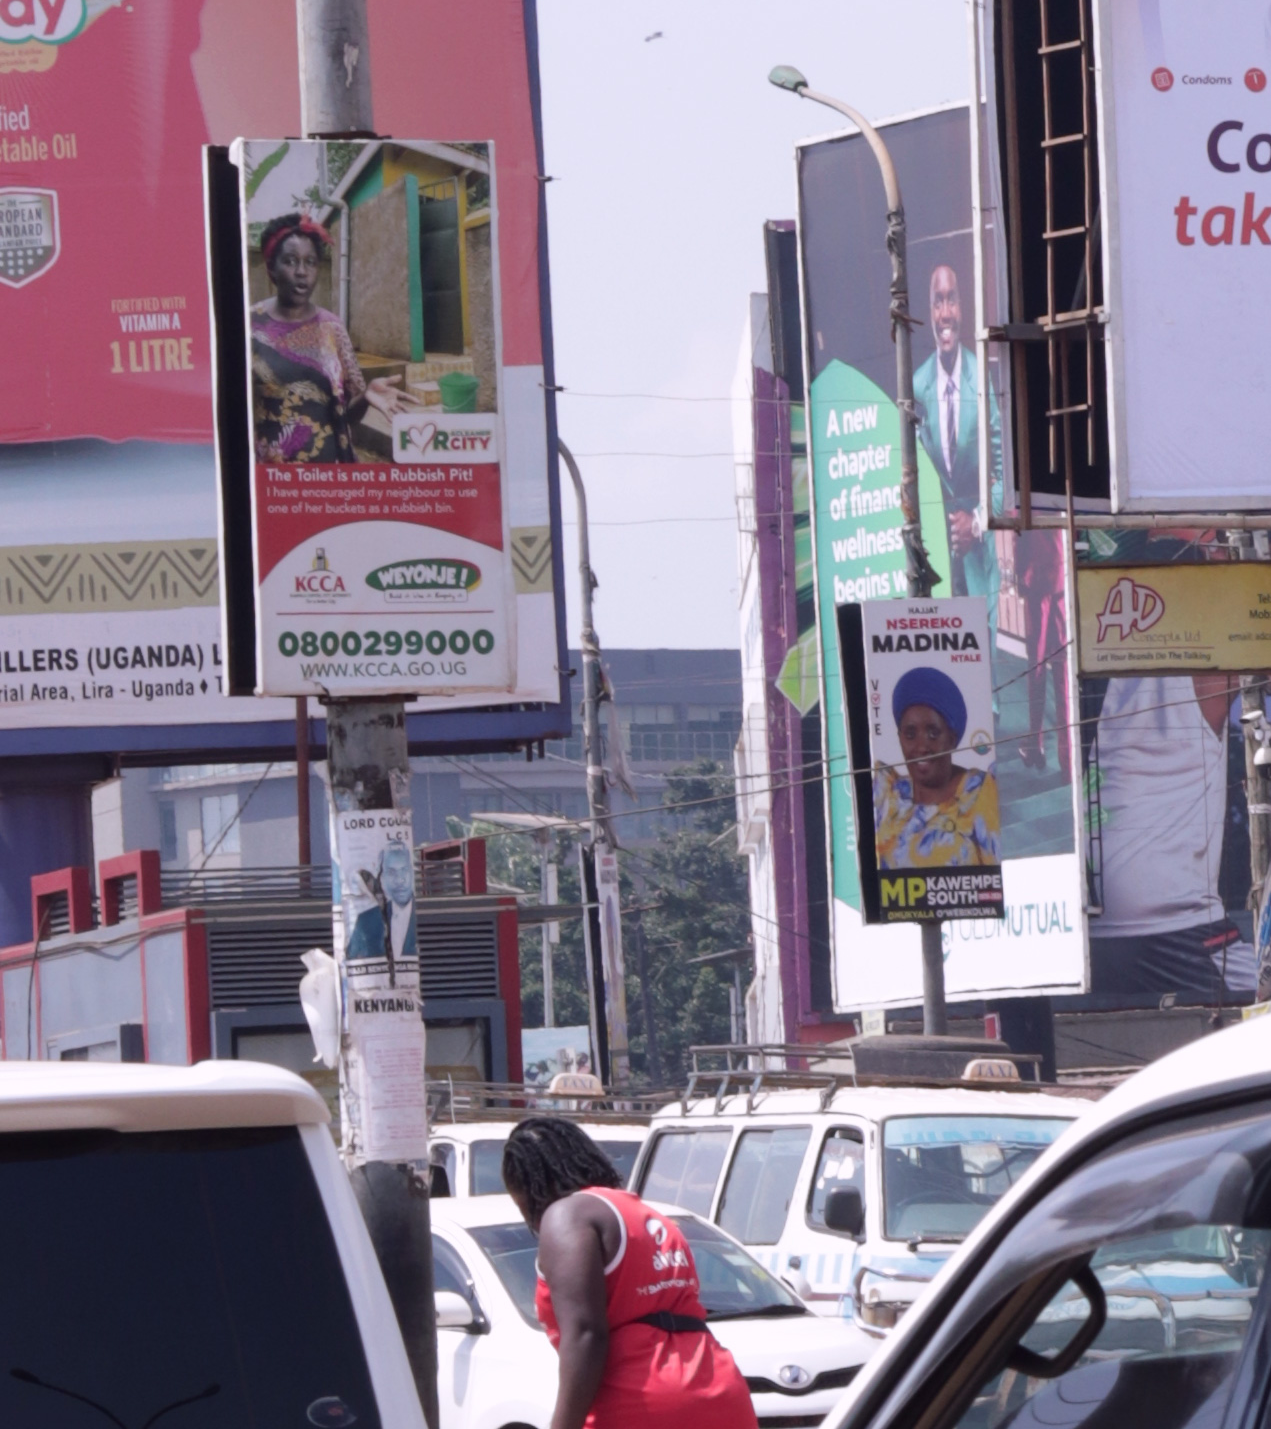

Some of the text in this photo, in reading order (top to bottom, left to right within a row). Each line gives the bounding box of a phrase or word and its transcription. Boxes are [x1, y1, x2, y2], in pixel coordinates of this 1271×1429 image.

[1181, 74, 1233, 86] Condoms
[52, 132, 77, 159] Oil
[119, 312, 181, 332] VITAMIN A
[110, 337, 194, 374] 1 LITRE
[826, 405, 879, 438] A new
[450, 437, 490, 450] CITY
[828, 444, 891, 481] chapter
[266, 467, 474, 482] The Toilet is not a Rubbish Pit!
[272, 486, 478, 500] have encouraged my neighbour to use
[267, 504, 288, 514] one
[291, 502, 304, 514] of
[305, 503, 322, 514] her
[325, 502, 367, 514] buckets
[368, 504, 380, 514] as
[392, 502, 433, 514] rubbish
[830, 488, 847, 521] of
[832, 526, 904, 563] wellness
[295, 575, 345, 592] KCCA
[1257, 593, 1271, 604] Tel:
[1096, 577, 1165, 644] AD
[1249, 609, 1271, 619] Mob:
[886, 617, 963, 630] NSEREKO
[278, 629, 495, 657] 0800299000
[872, 632, 979, 653] MADINA
[87, 643, 204, 677] (UGANDA)
[951, 654, 981, 663] NTALE
[1110, 652, 1127, 662] Your
[1168, 651, 1182, 660] The
[300, 661, 467, 678] WWW.KCCA.GO.UG
[31, 684, 75, 702] Area,
[82, 681, 113, 699] Lira
[132, 678, 194, 701] Uganda
[344, 818, 375, 830] LORD
[926, 874, 1001, 891] KAWEMPE
[881, 877, 979, 908] MP SOUTH
[976, 1063, 1012, 1078] TAXI
[562, 1077, 593, 1090] TAXI
